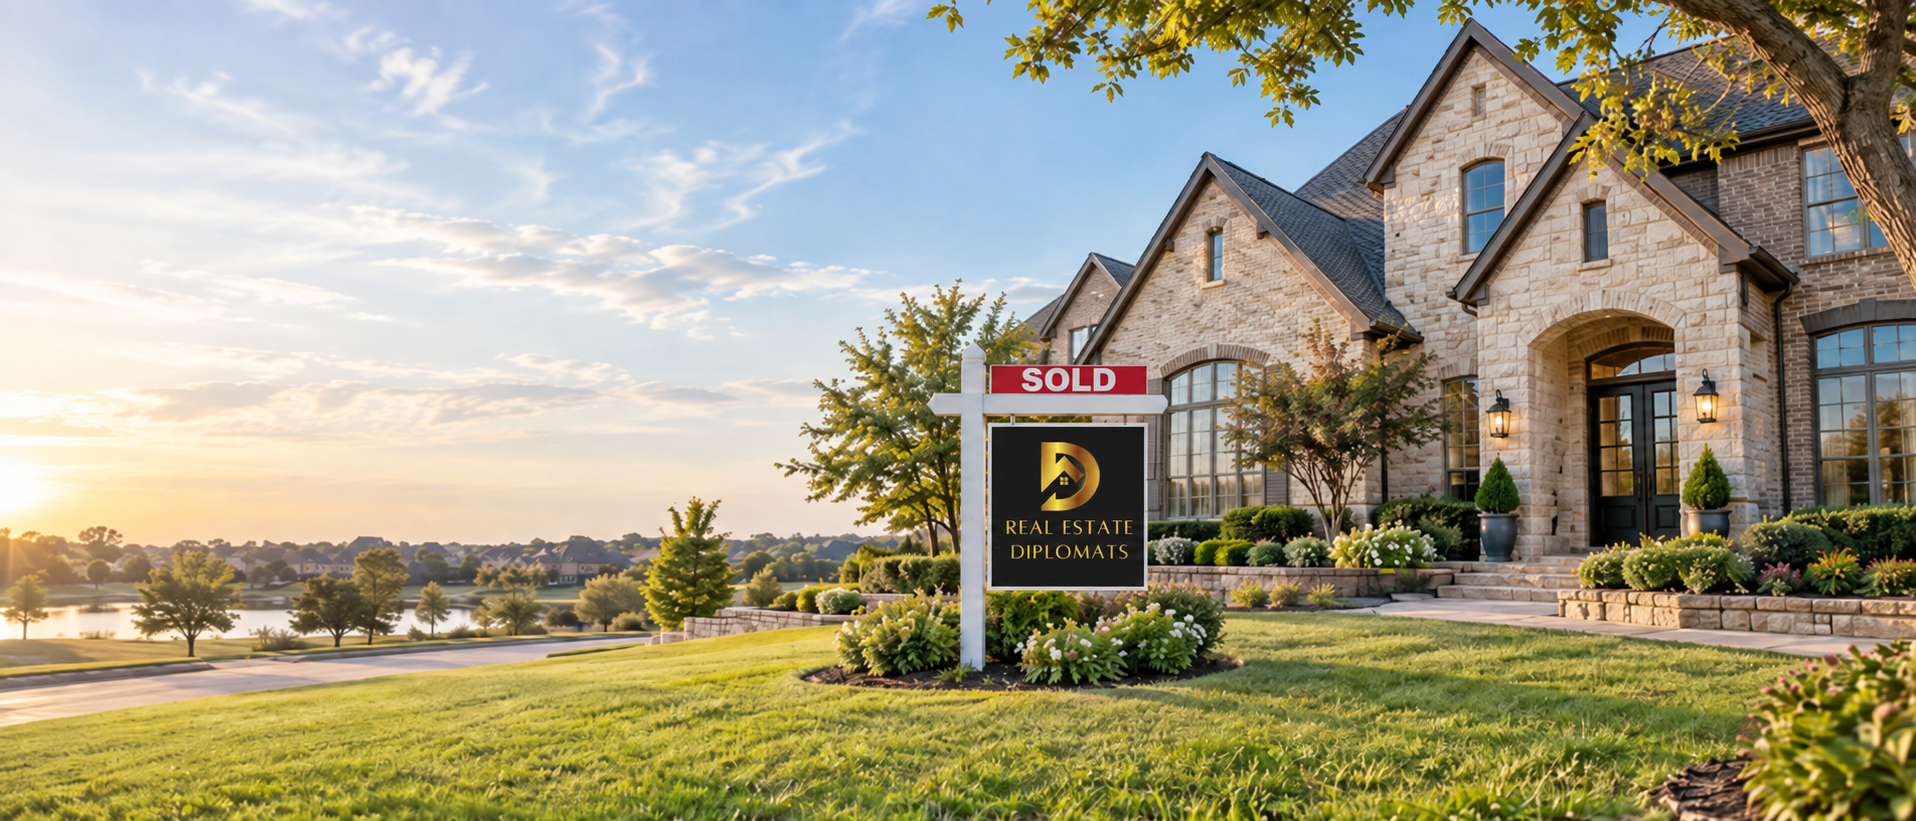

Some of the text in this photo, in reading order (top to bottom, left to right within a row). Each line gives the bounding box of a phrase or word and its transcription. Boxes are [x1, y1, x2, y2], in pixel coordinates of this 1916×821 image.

[1021, 367, 1116, 392] SOLD
[1006, 519, 1134, 535] REAL ESTATE
[1011, 544, 1129, 560] DIPLOMATS
